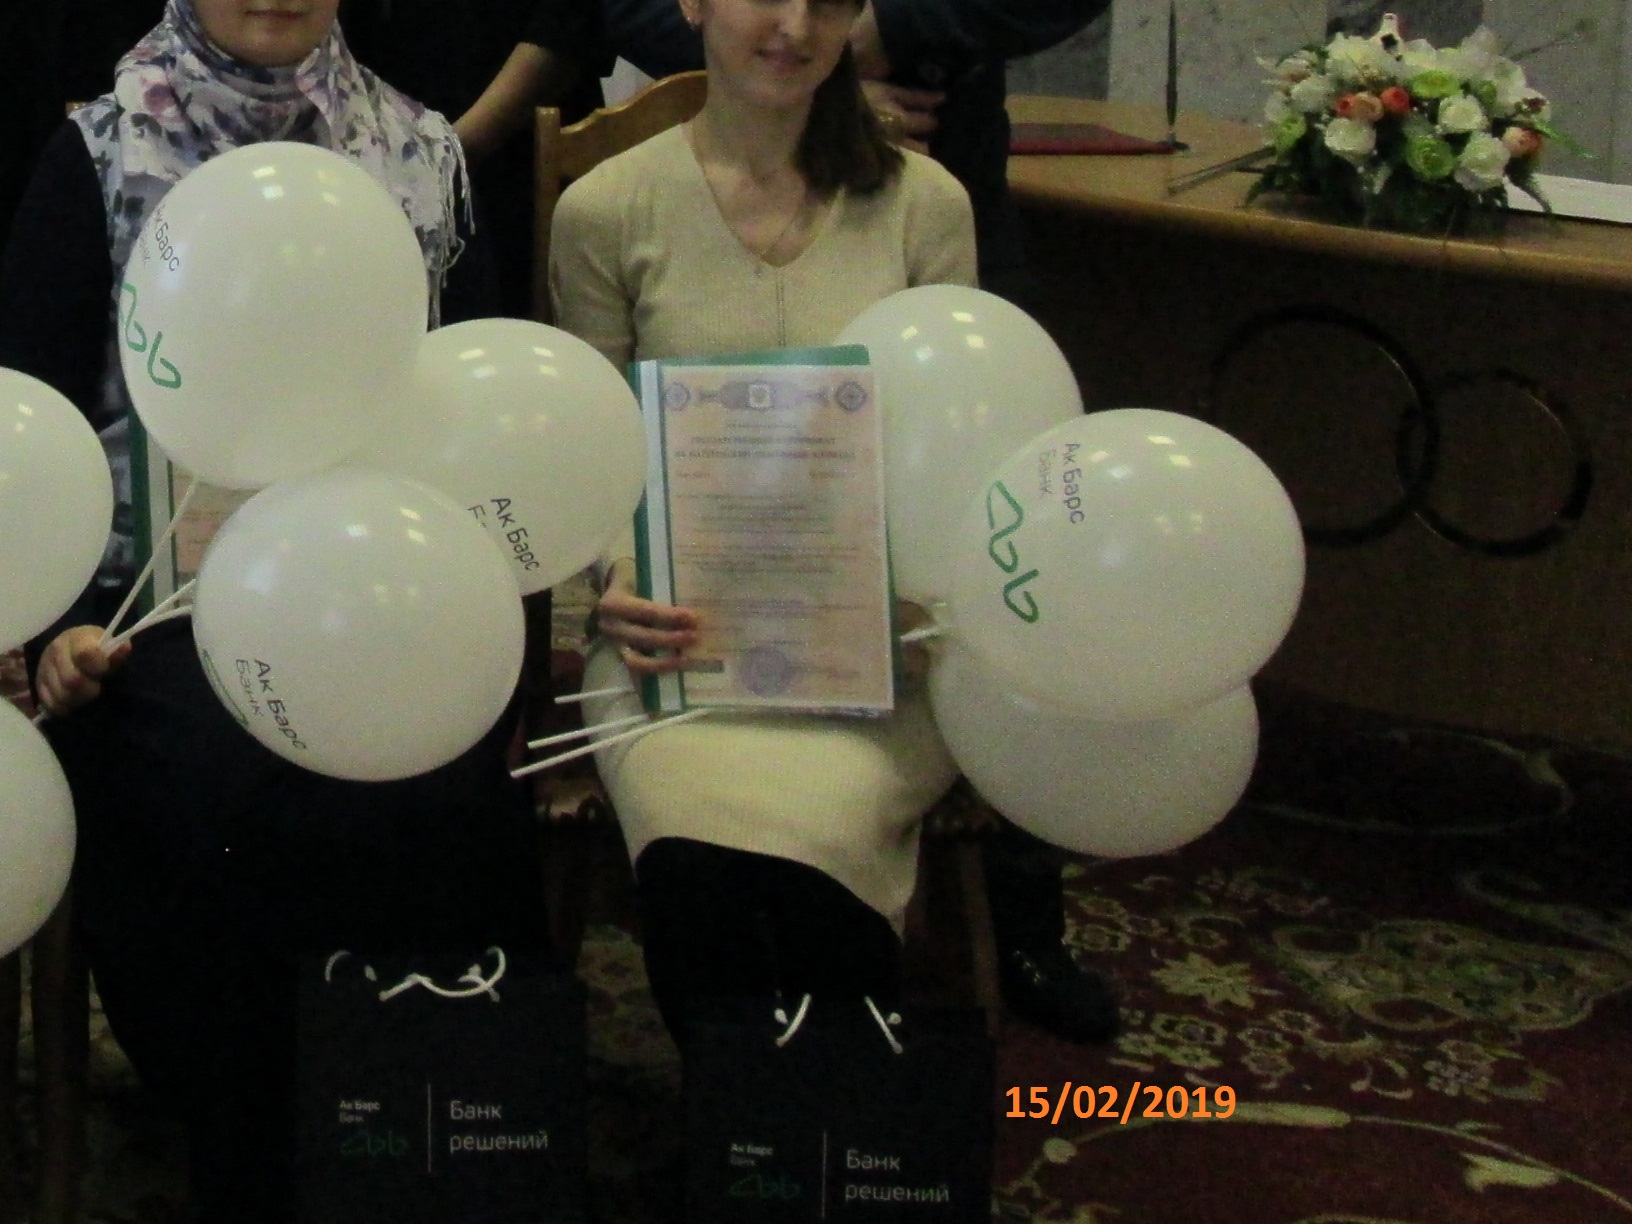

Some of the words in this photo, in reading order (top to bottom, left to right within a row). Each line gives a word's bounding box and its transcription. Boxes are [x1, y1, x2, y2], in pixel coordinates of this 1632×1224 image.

[155, 222, 180, 272] Барс
[1063, 443, 1081, 465] Ак
[1063, 468, 1085, 524] Барс
[490, 497, 516, 528] Ак
[506, 527, 540, 571] Барс
[254, 658, 273, 693] Ак
[267, 698, 308, 750] Барс
[355, 1099, 381, 1113] Барс
[450, 1100, 502, 1120] Банк
[450, 1129, 548, 1154] решений
[846, 1148, 901, 1171] Банк
[845, 1183, 950, 1203] решений
